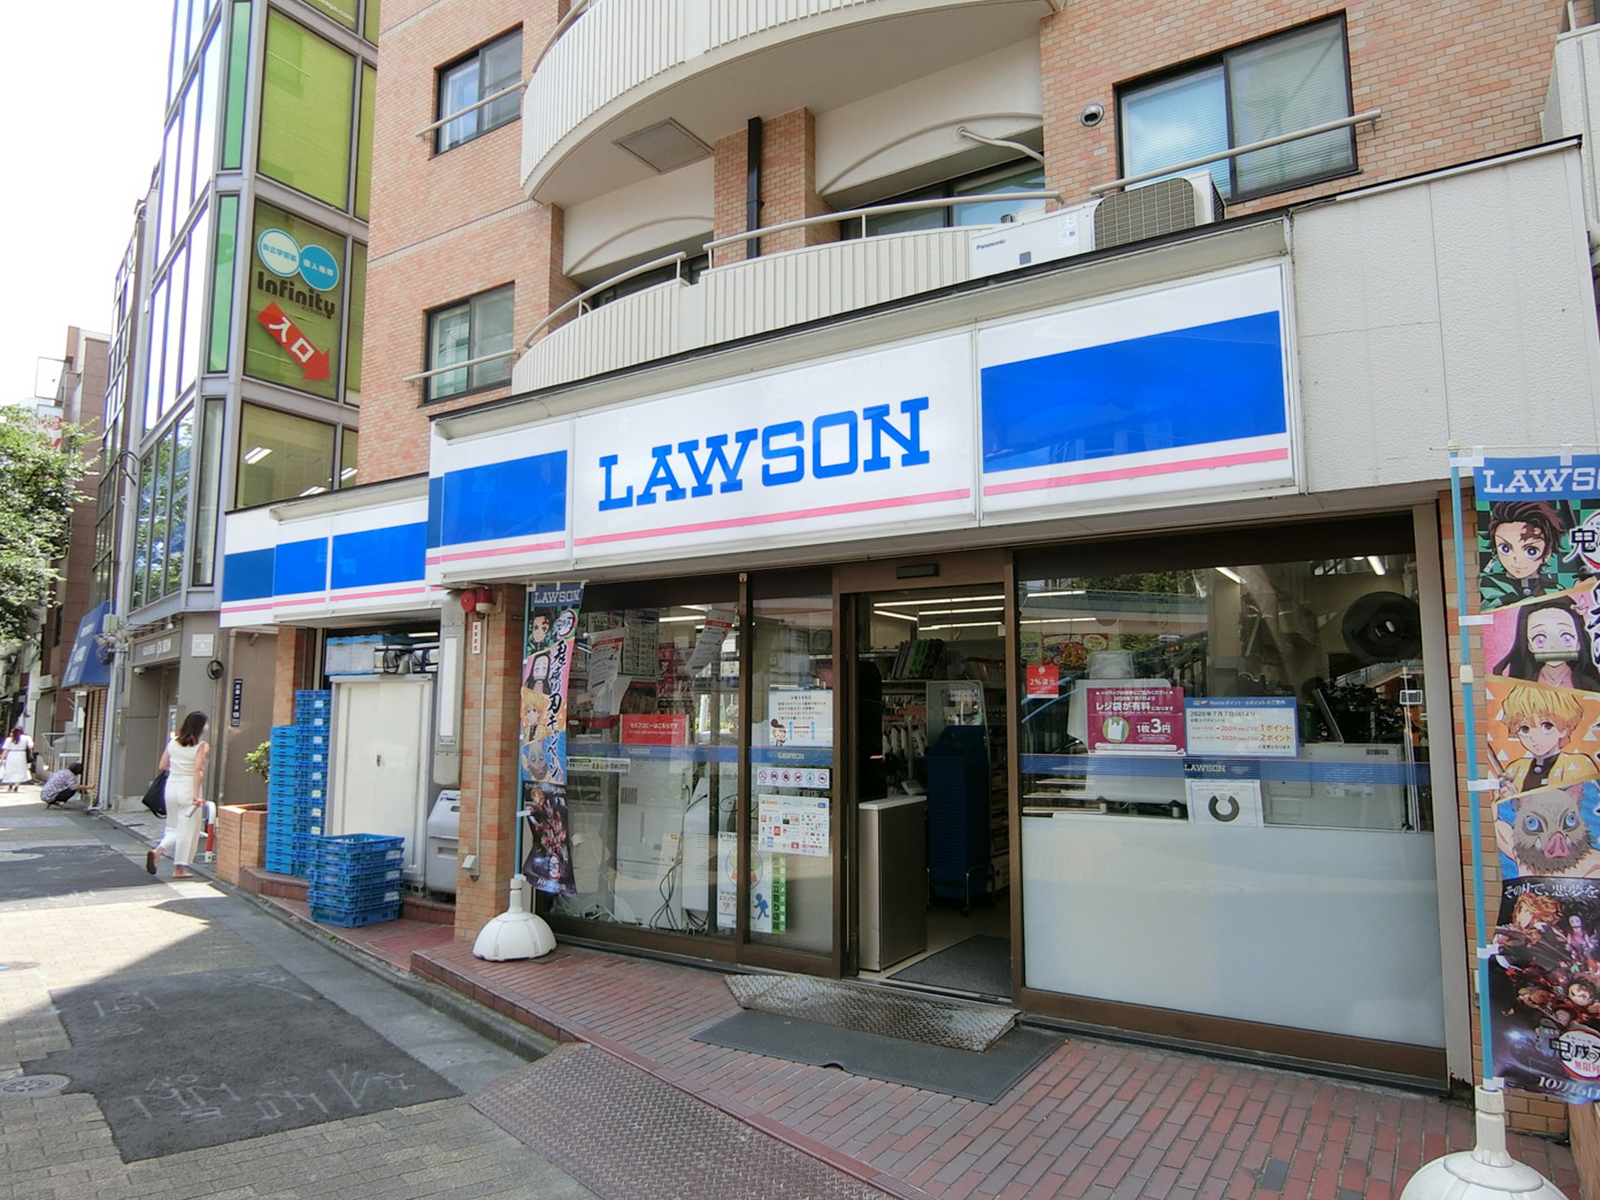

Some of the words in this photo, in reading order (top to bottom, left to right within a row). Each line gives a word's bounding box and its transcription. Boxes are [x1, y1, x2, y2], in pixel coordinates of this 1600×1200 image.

[976, 239, 1006, 250] Panasonic
[257, 270, 336, 320] Infinity
[268, 316, 315, 363] 入口
[598, 396, 930, 511] LAWSON
[1483, 467, 1600, 494] LAWS
[533, 589, 581, 604] LAWSON
[1183, 764, 1227, 772] LAWSON
